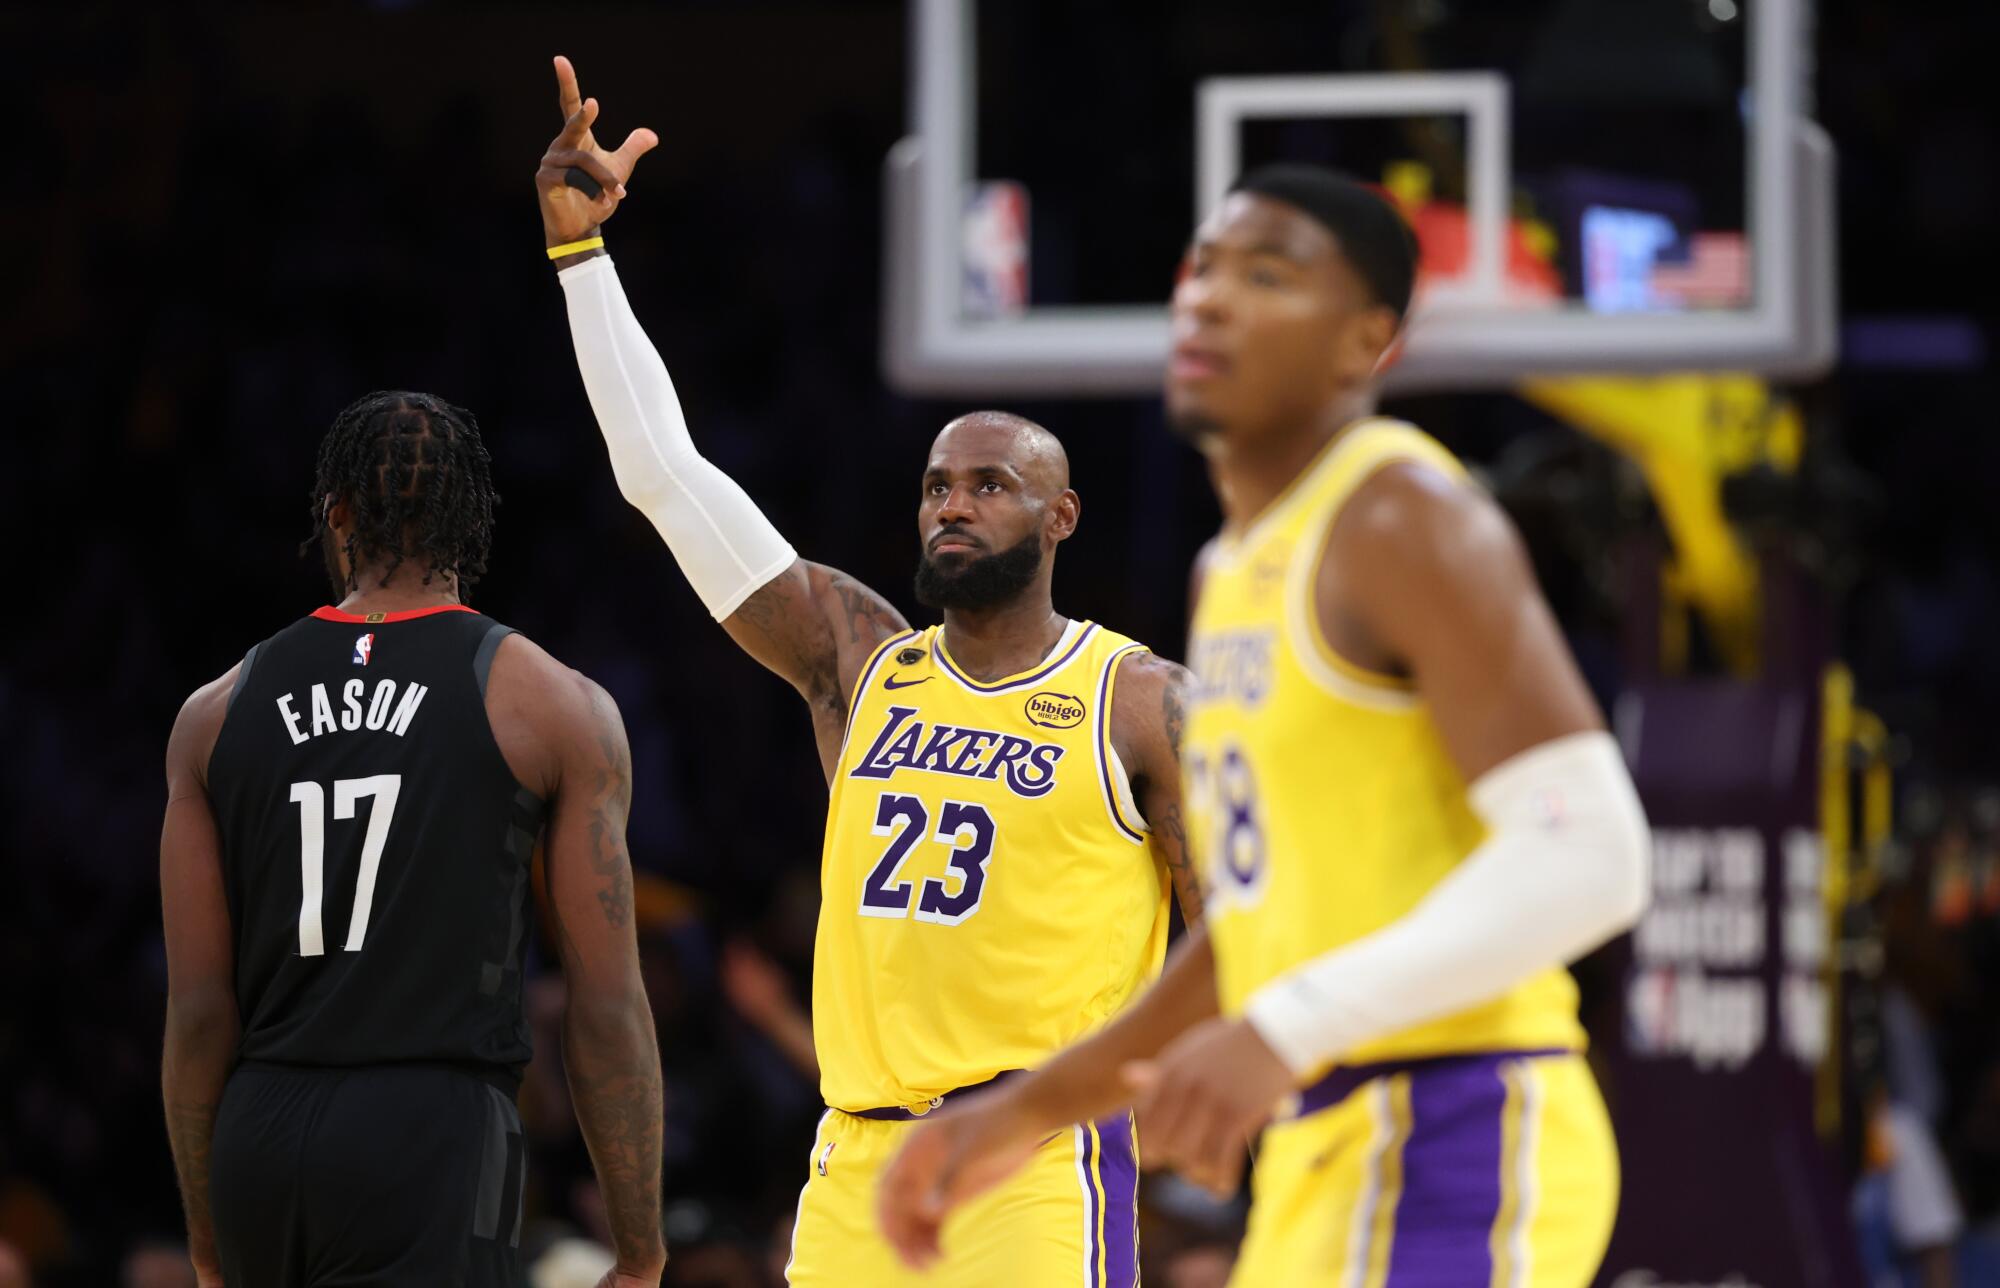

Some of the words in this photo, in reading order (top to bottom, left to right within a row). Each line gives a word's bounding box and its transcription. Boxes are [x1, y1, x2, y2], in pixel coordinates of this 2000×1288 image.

[276, 678, 428, 745] EASON
[850, 705, 1066, 798] LAKERS
[1031, 699, 1082, 720] bibigo
[290, 774, 402, 957] 17
[859, 792, 996, 926] 23
